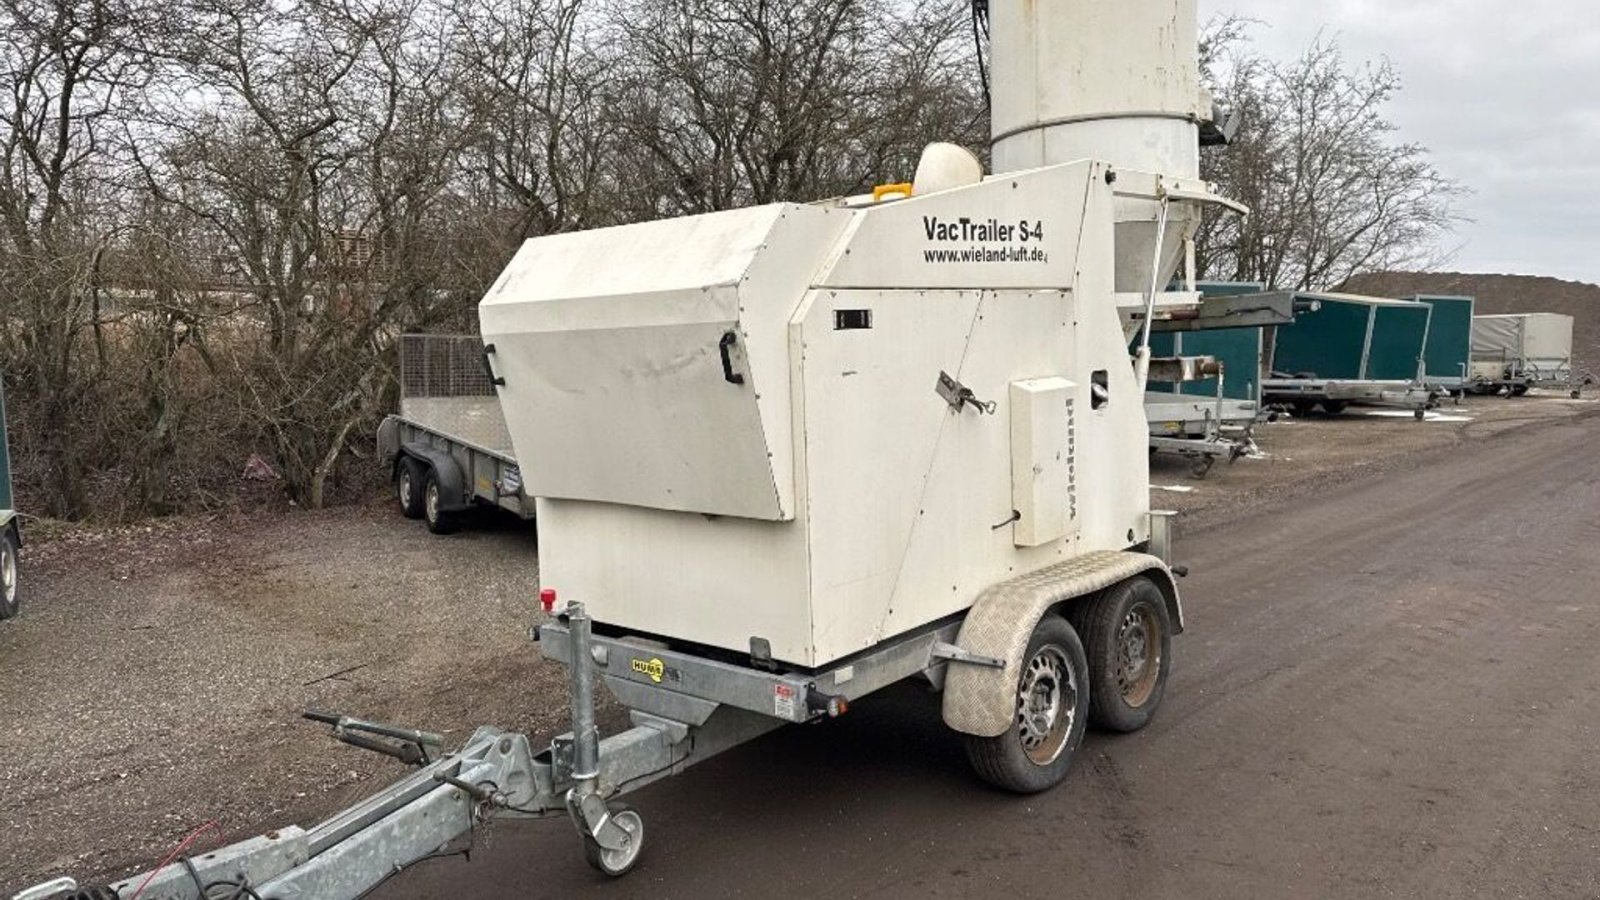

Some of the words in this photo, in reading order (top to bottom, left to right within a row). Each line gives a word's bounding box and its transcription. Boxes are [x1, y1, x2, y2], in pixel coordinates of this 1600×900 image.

[923, 216, 1015, 241] VacTrailer
[1019, 219, 1043, 241] S-4
[923, 246, 1044, 262] www.wieland-luft.de
